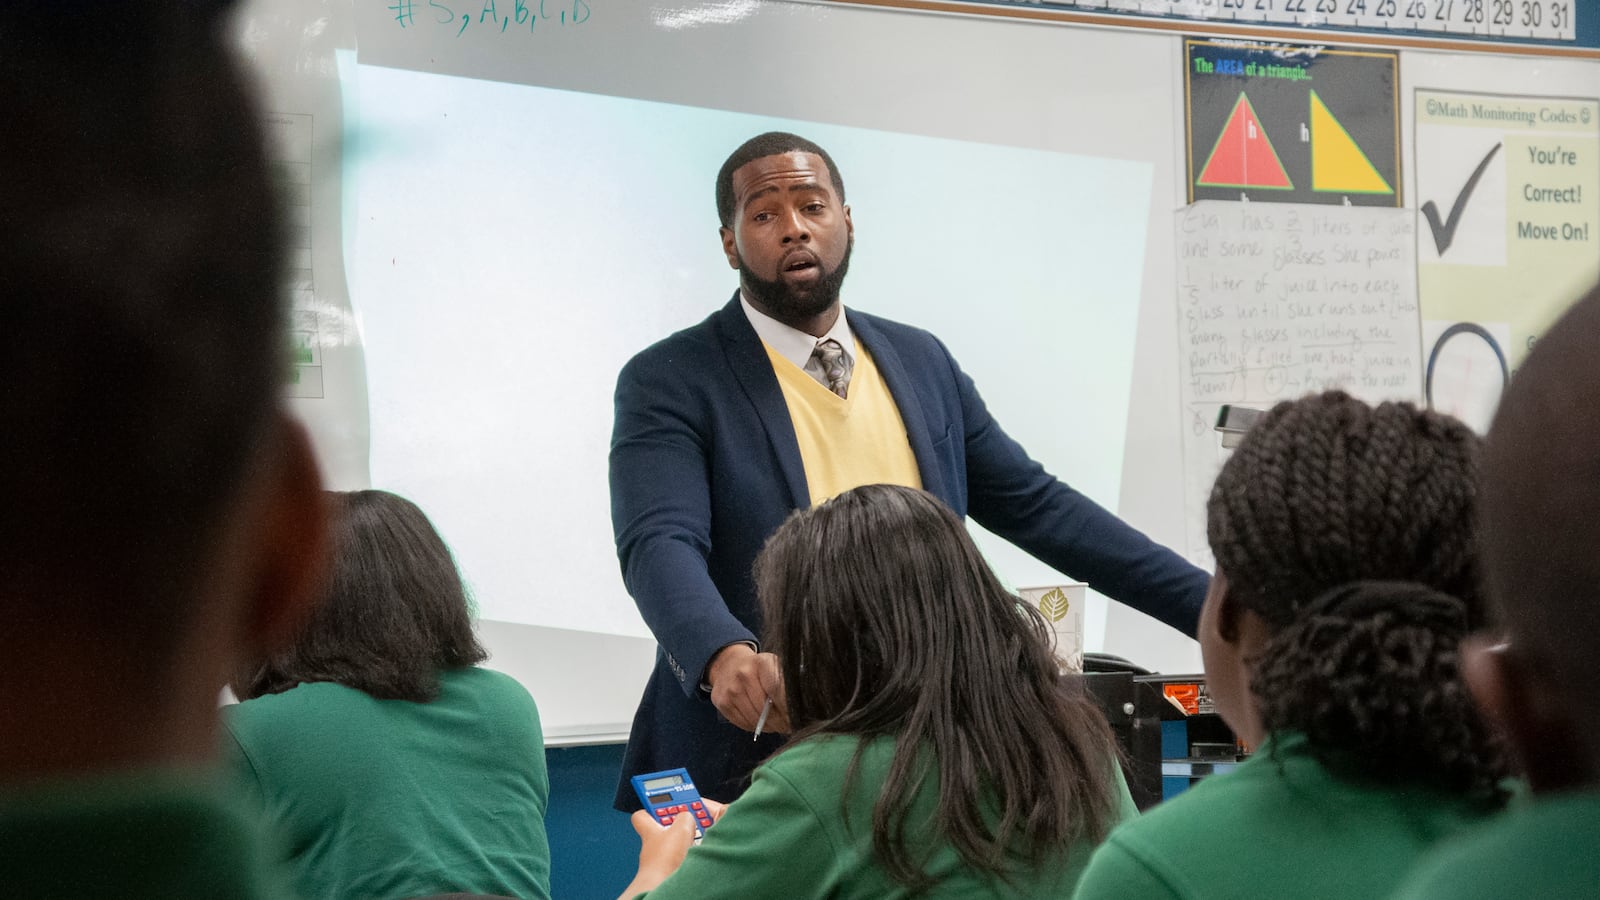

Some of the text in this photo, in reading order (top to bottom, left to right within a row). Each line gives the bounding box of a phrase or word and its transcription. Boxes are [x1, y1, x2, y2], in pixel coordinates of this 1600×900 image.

[1346, 0, 1367, 15] 24
[1376, 0, 1397, 17] 25
[1405, 0, 1427, 19] 26
[1435, 0, 1452, 21] 27
[1464, 0, 1484, 23] 28
[1493, 0, 1513, 25] 29
[1521, 1, 1542, 27] 30
[1551, 3, 1569, 28] 31
[1194, 57, 1214, 74] The
[1216, 58, 1244, 75] AREA
[1246, 61, 1257, 77] of
[1258, 66, 1266, 77] a
[1438, 102, 1577, 126] Math Monitoring Codes
[1248, 120, 1257, 140] h
[1301, 123, 1310, 142] h
[1528, 146, 1577, 165] You're
[1523, 184, 1582, 203] Correct!
[1241, 209, 1274, 231] has
[1312, 216, 1352, 236] liters
[1518, 221, 1589, 241] Move On!
[1182, 239, 1209, 258] and
[1220, 240, 1264, 257] some
[1211, 271, 1243, 293] liter
[1255, 271, 1270, 293] of
[1323, 275, 1359, 294] into
[1236, 302, 1279, 320] until
[1318, 303, 1356, 315] runs
[1191, 331, 1228, 356] many
[1296, 321, 1361, 352] including
[1368, 325, 1393, 338] the
[1256, 346, 1292, 364] filled
